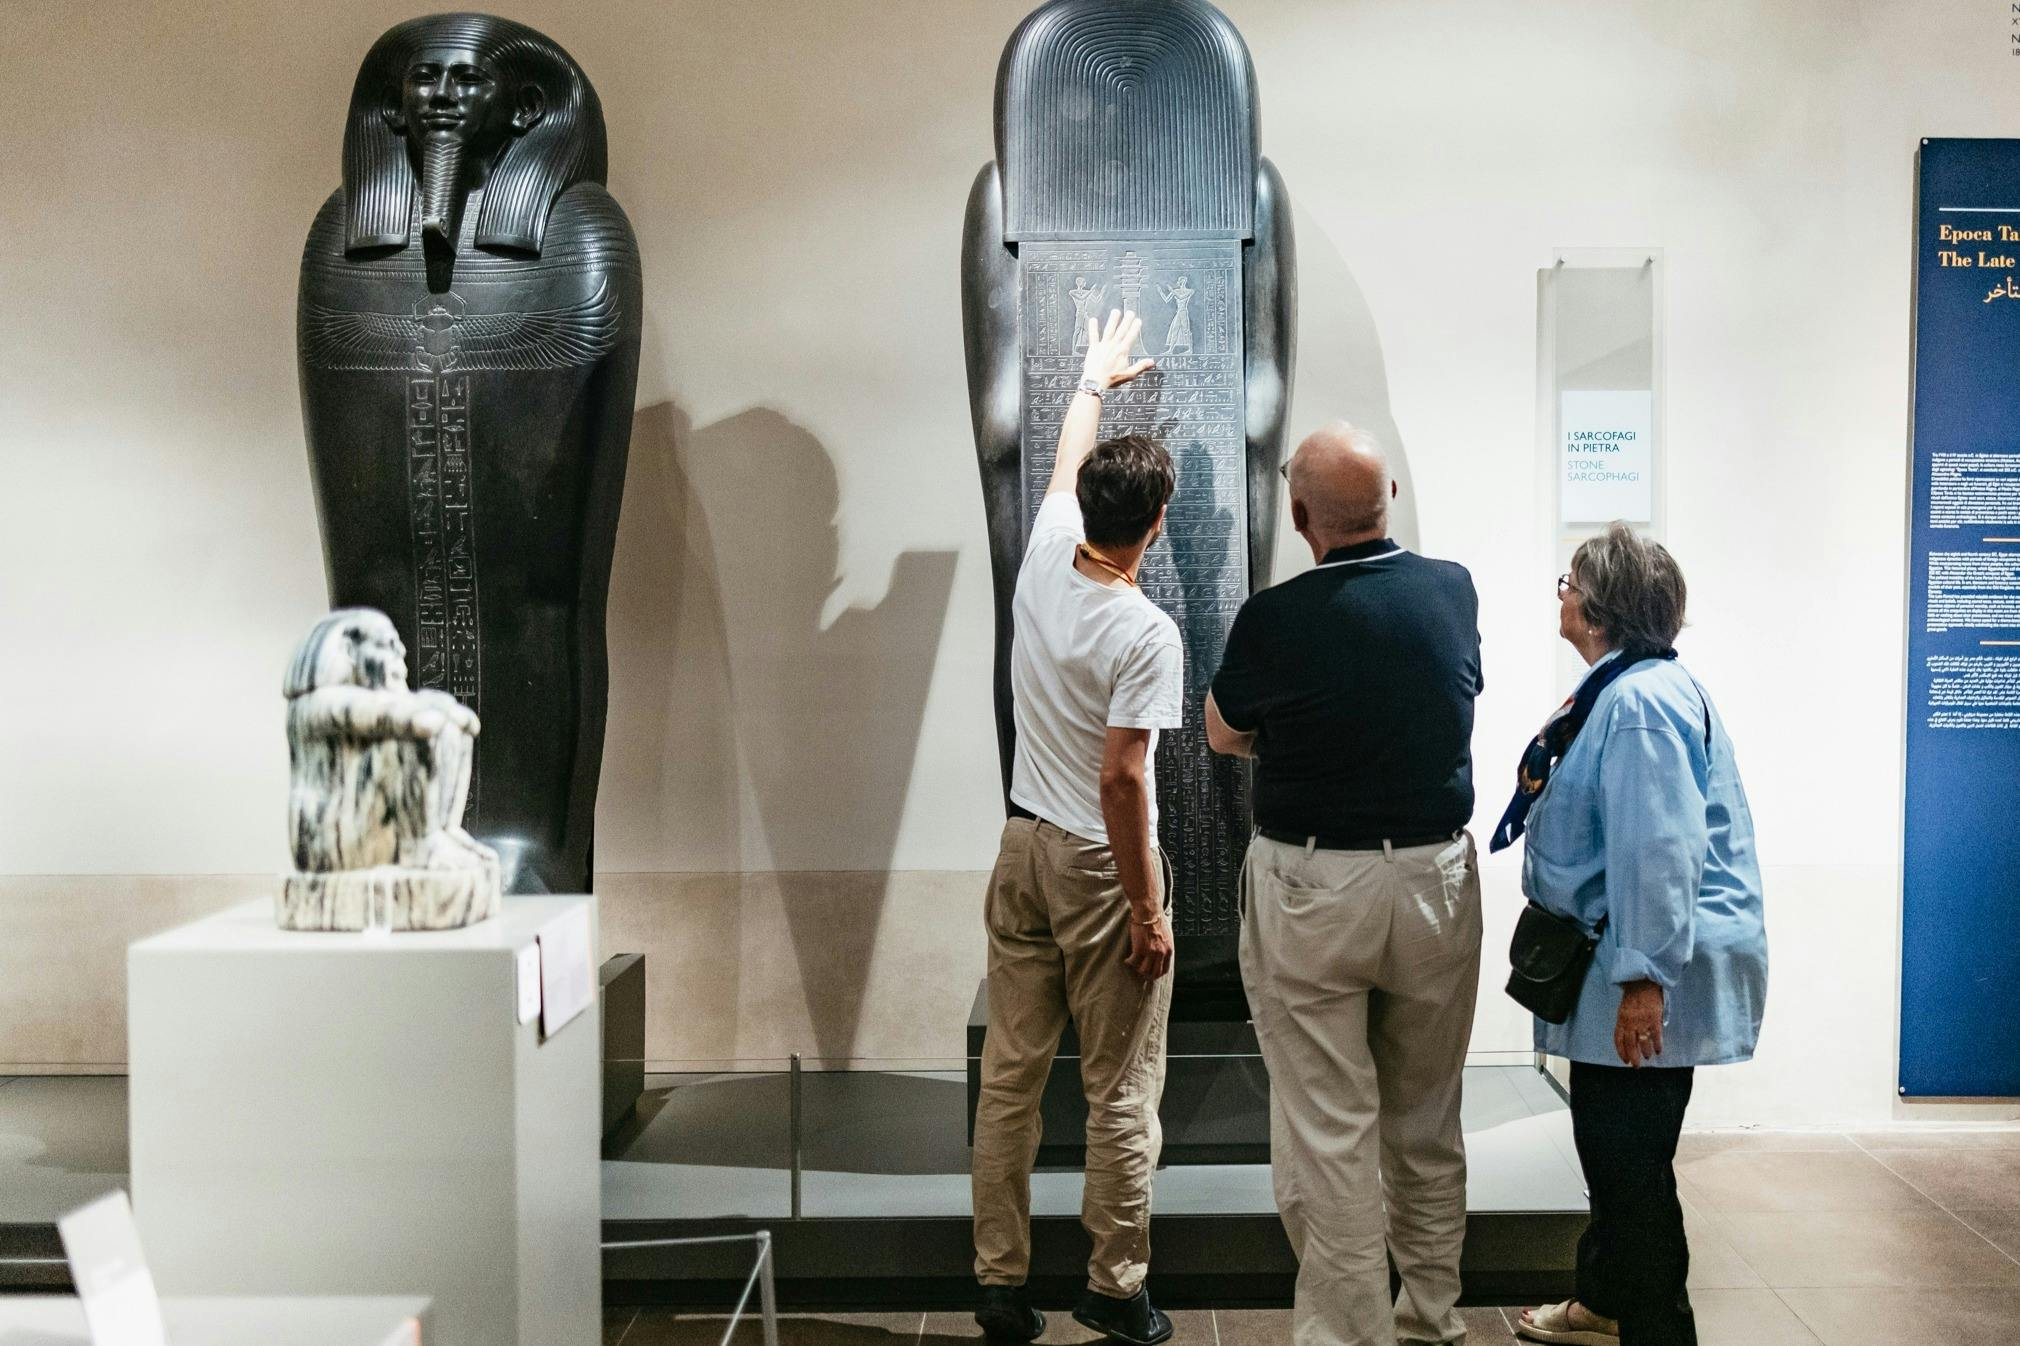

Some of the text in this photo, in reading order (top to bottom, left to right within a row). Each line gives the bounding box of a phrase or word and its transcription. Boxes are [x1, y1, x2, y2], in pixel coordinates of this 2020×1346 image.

[1939, 224, 1992, 244] Epoca
[1938, 251, 2015, 268] The Late
[1574, 431, 1636, 441] SARCOFAGI
[1567, 443, 1620, 453] IN PIETRA
[1567, 460, 1605, 470] STONE
[1567, 472, 1639, 482] SARCOPHAGI
